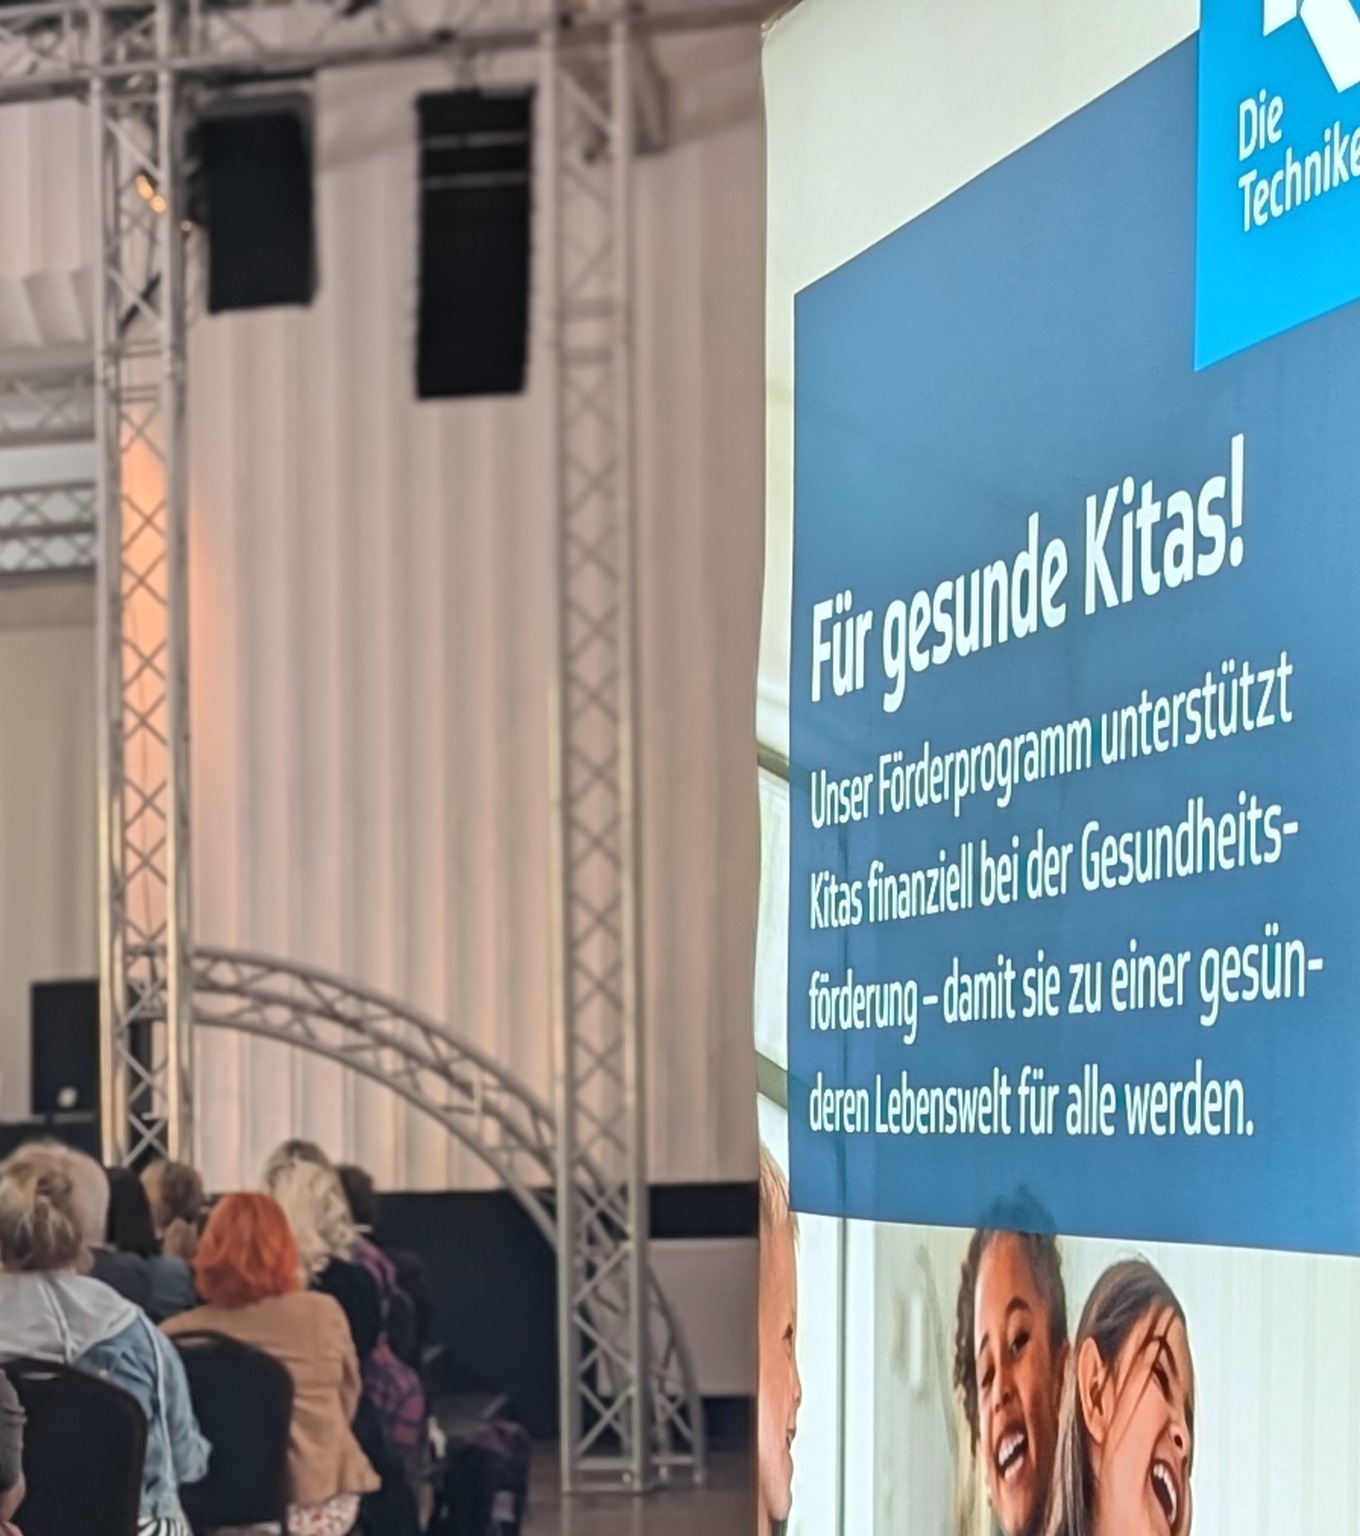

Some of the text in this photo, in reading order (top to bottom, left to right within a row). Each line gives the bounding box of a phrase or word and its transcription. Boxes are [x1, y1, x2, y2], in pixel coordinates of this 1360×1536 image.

[1238, 88, 1284, 161] Die
[811, 433, 1245, 713] Für gesunde Kitas!
[811, 650, 1293, 829] Unser Förderprogramm unterstützt
[810, 790, 1299, 930] Kitas finanziell bei der Gesundheits-
[808, 968, 918, 1045] förderung
[943, 954, 1016, 1024] damit
[1022, 949, 1061, 1018] sie
[1068, 961, 1102, 1014] zu
[1111, 938, 1191, 1012] einer
[1200, 922, 1323, 1027] gesün-
[809, 1058, 1254, 1136] deren Lebenswelt für alle werden.
